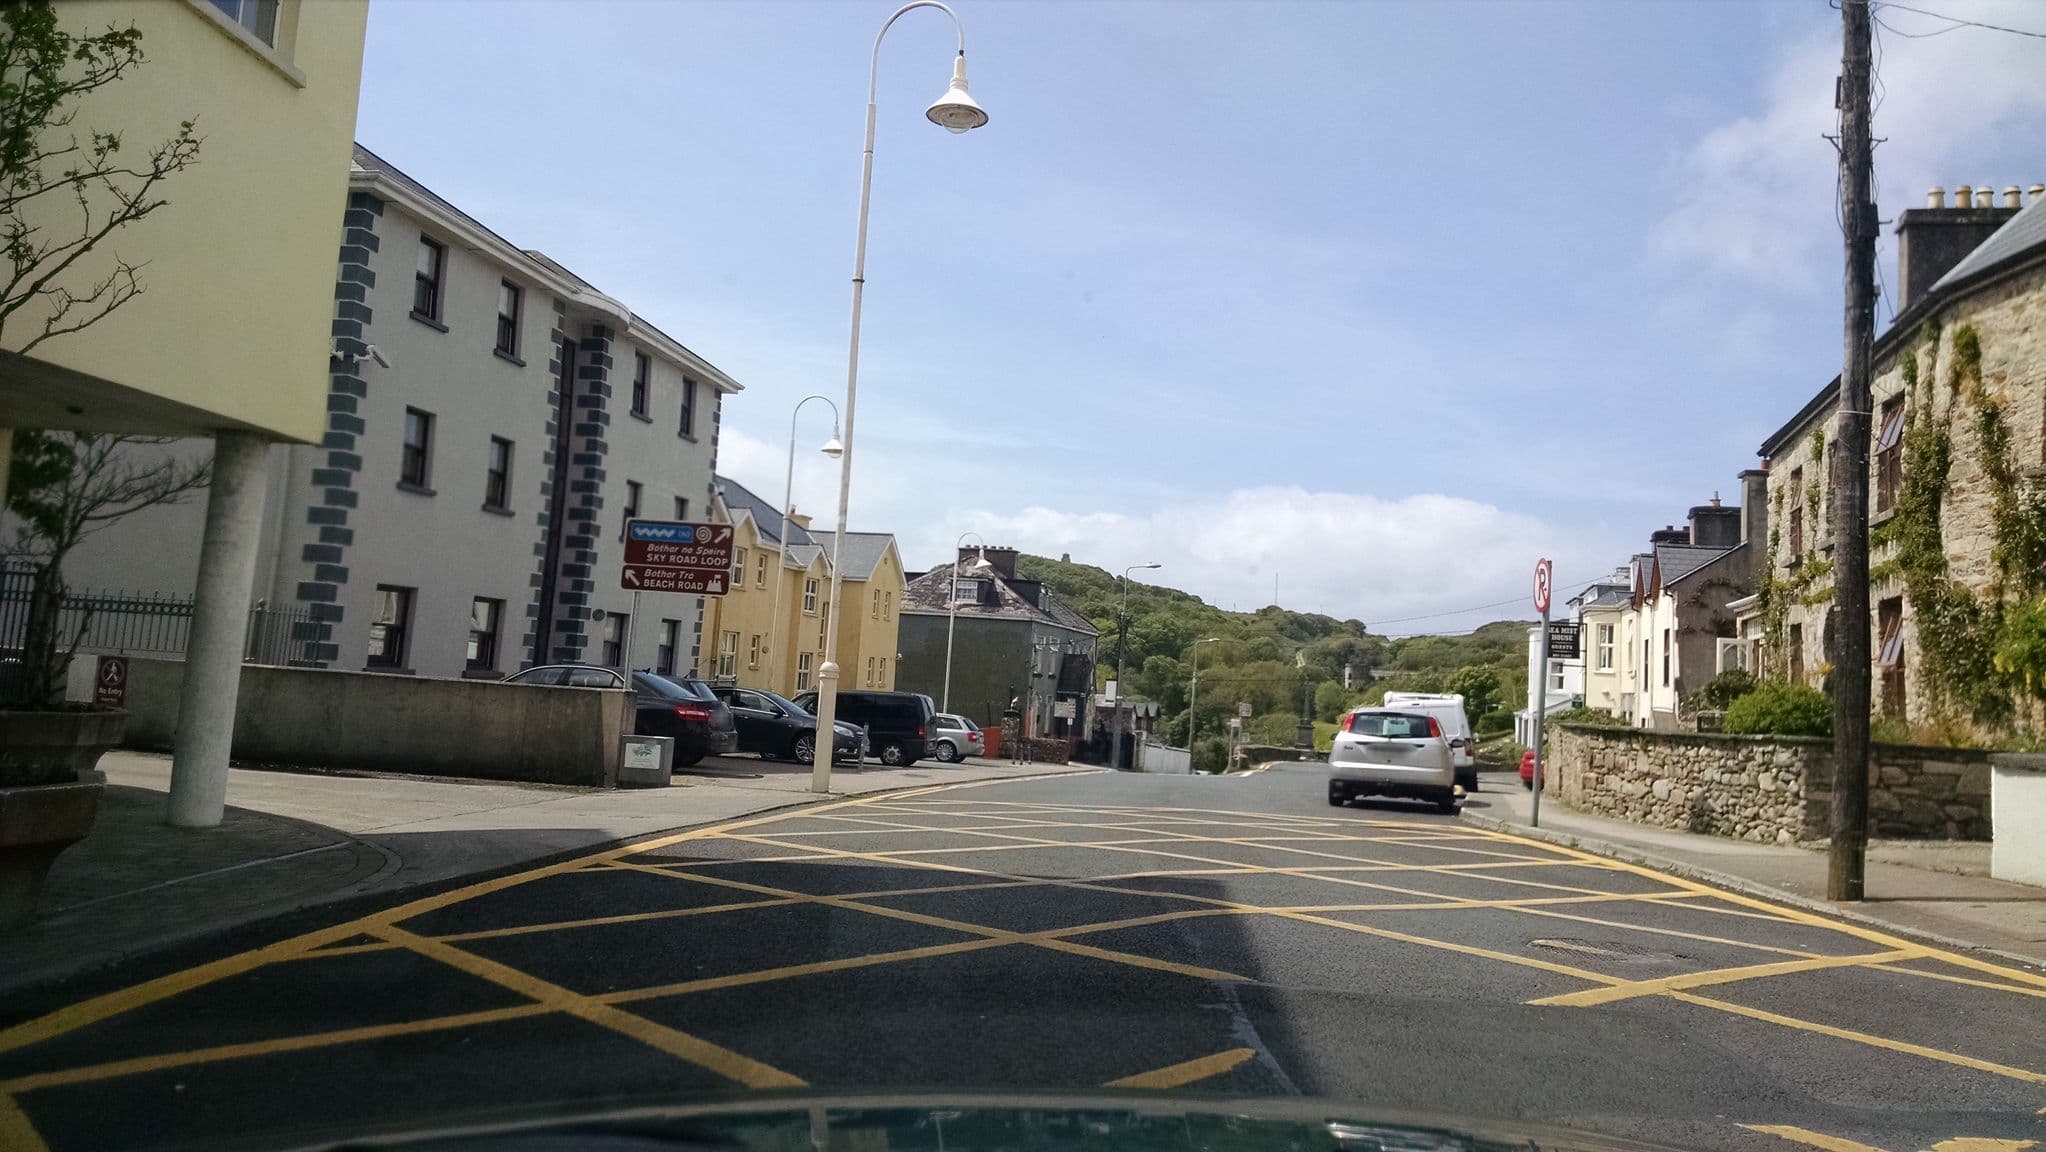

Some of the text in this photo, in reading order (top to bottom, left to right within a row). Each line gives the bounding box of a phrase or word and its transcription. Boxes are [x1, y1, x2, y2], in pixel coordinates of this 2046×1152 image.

[646, 553, 729, 566] SKY ROAD LOOP
[643, 579, 704, 591] BEACH ROAD
